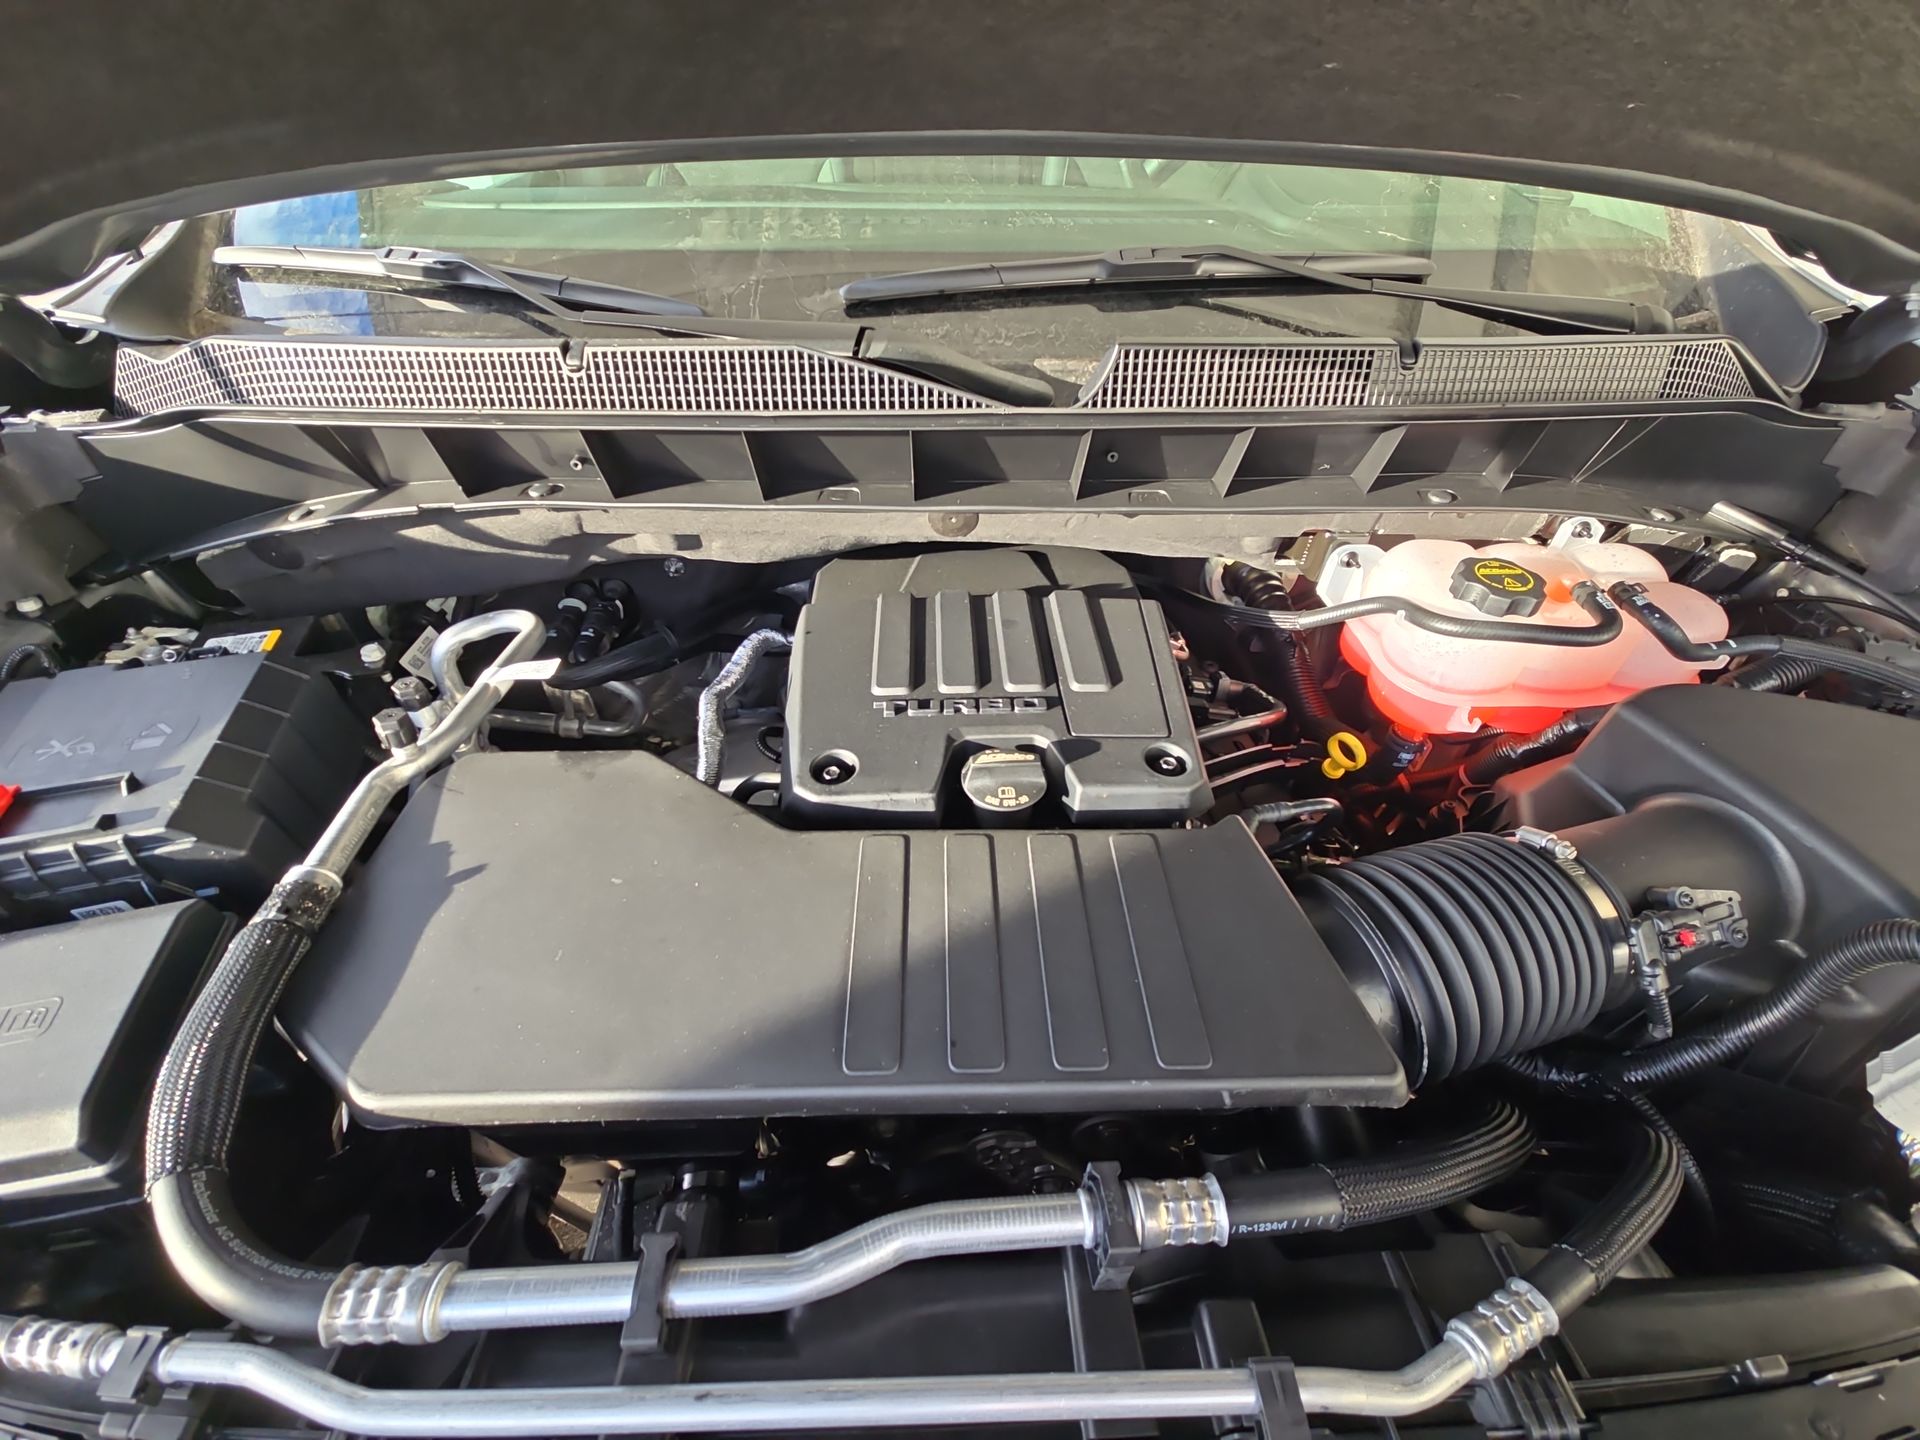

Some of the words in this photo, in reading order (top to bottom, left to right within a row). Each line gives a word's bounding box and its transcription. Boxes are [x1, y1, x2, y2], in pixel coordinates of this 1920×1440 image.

[873, 697, 1048, 718] TURBO
[975, 752, 1036, 765] ACDelco
[228, 1238, 272, 1268] SUCTION
